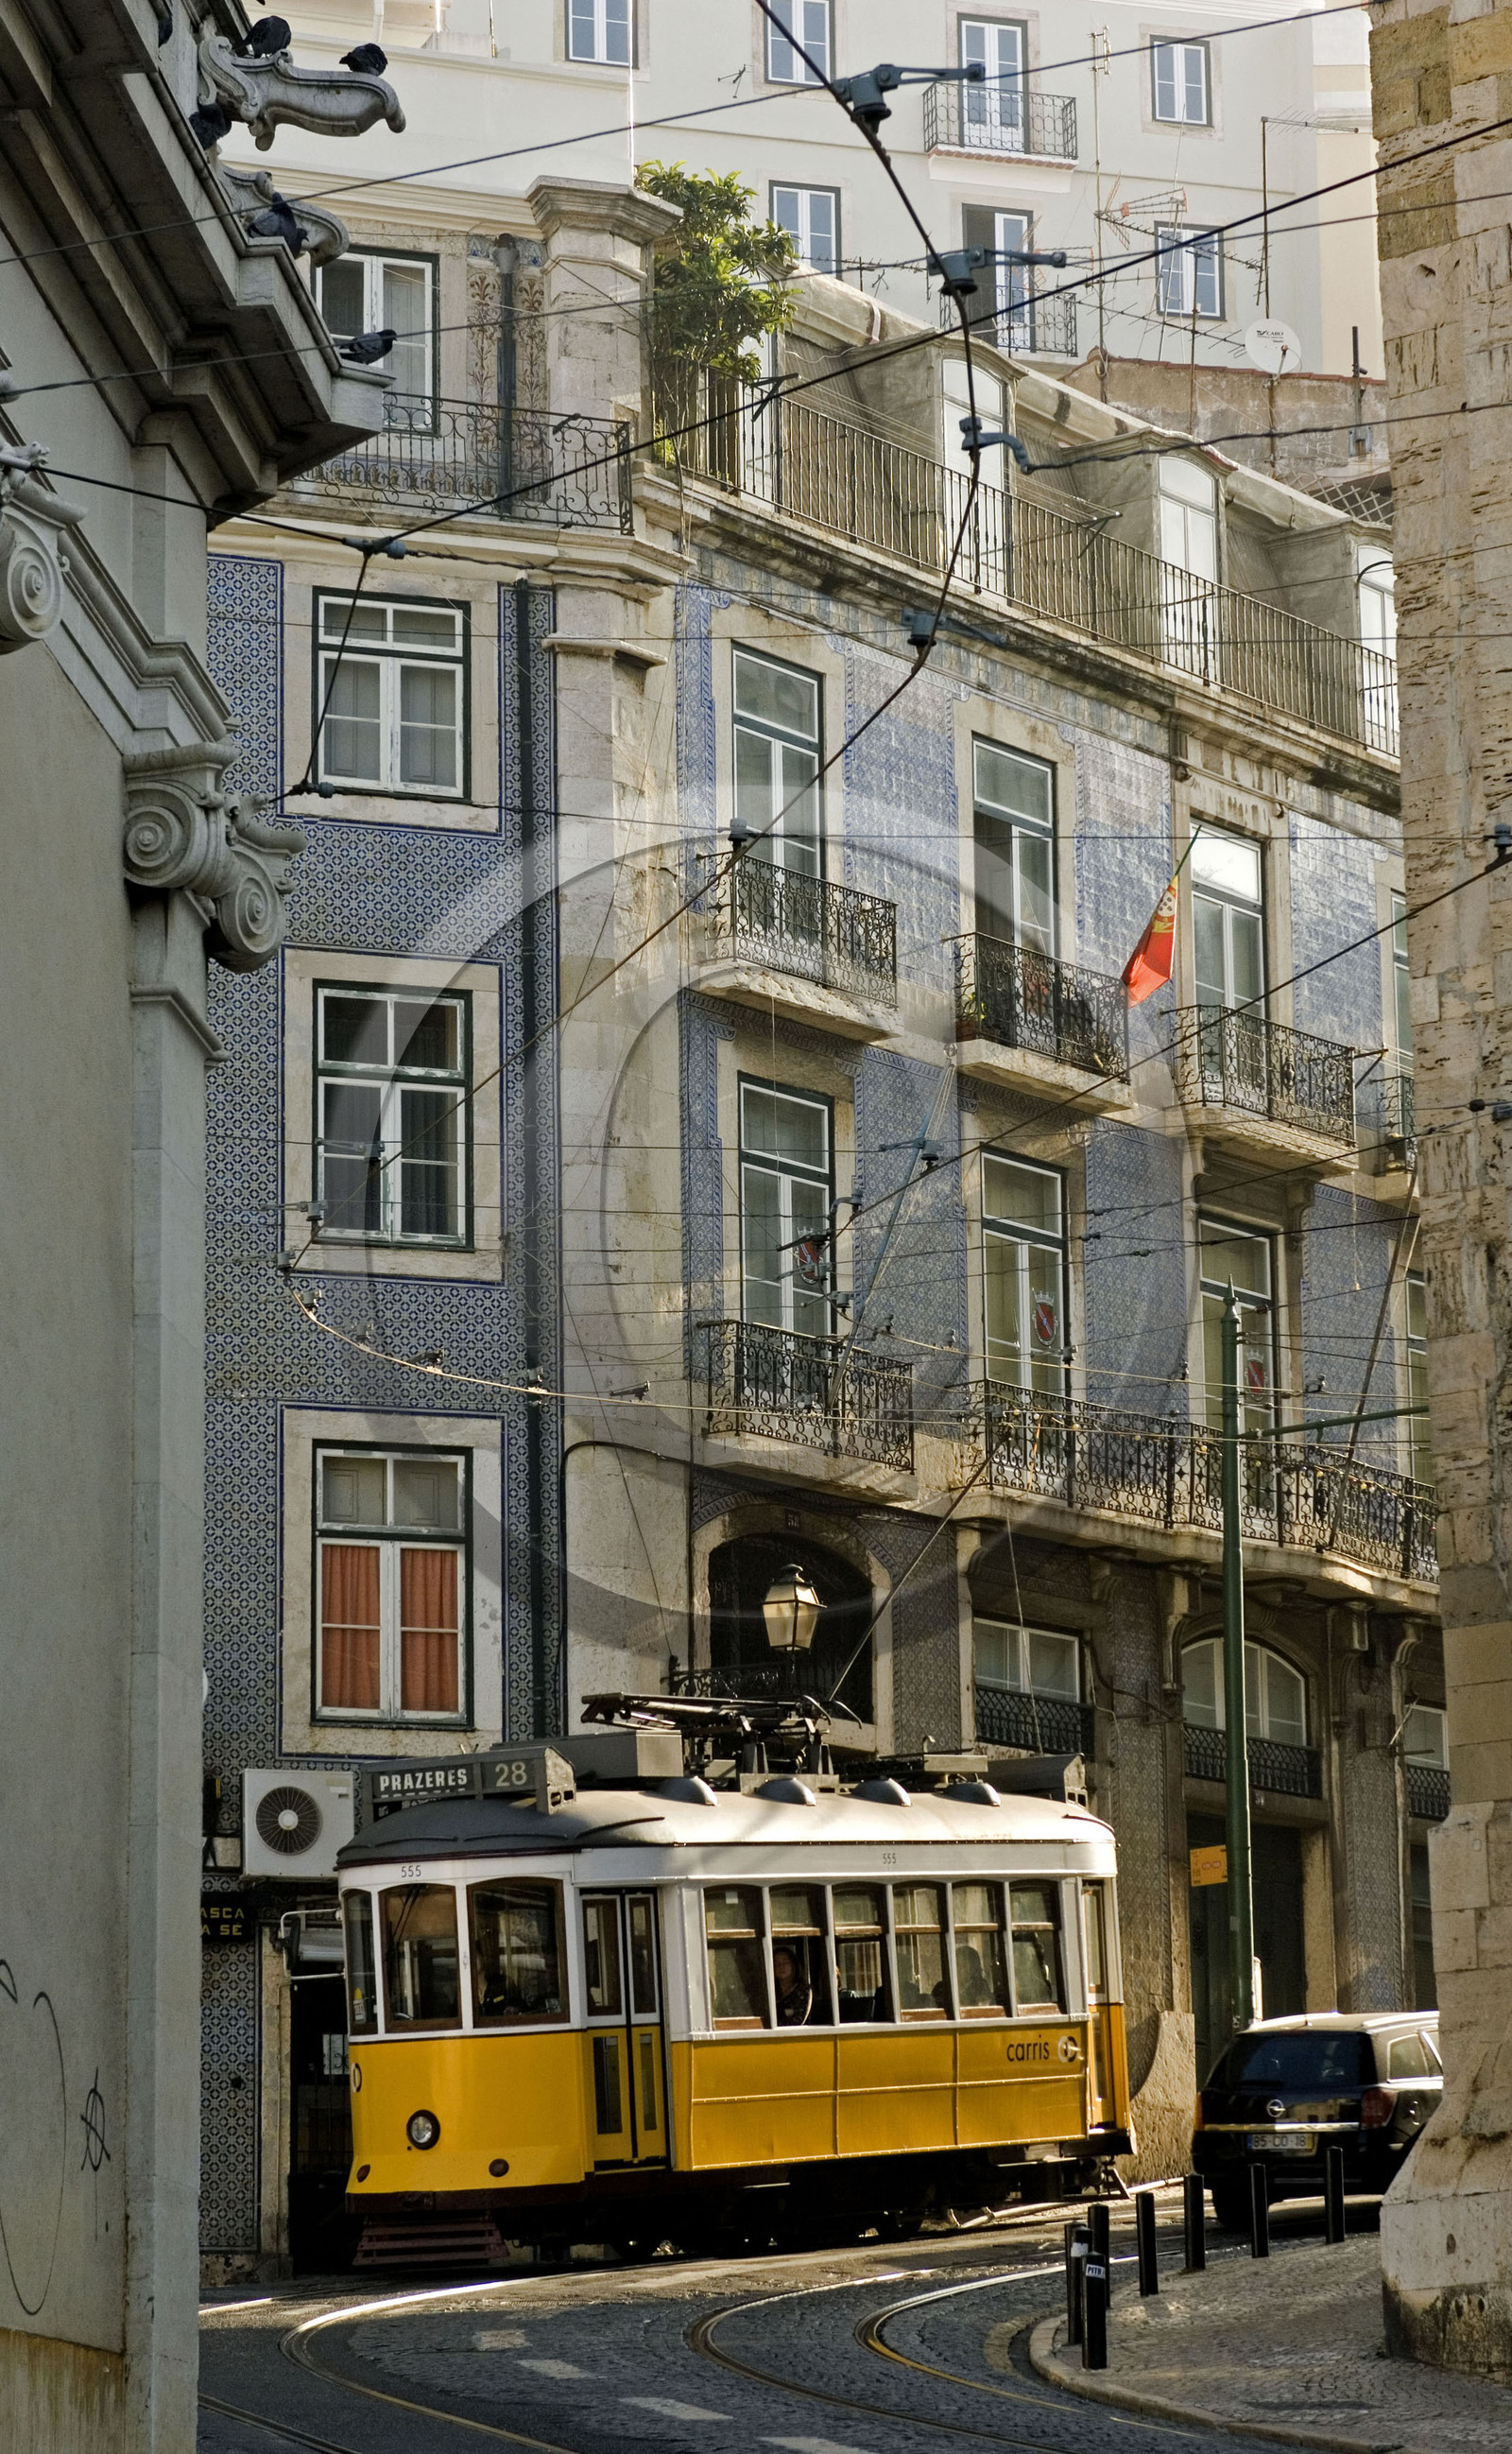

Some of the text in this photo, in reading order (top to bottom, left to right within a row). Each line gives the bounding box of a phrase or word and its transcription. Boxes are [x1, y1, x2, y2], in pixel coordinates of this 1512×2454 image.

[380, 1761, 528, 1792] PRAZERES 28
[883, 1852, 897, 1865] 555
[401, 1864, 422, 1878] 555
[1006, 2033, 1050, 2062] carris
